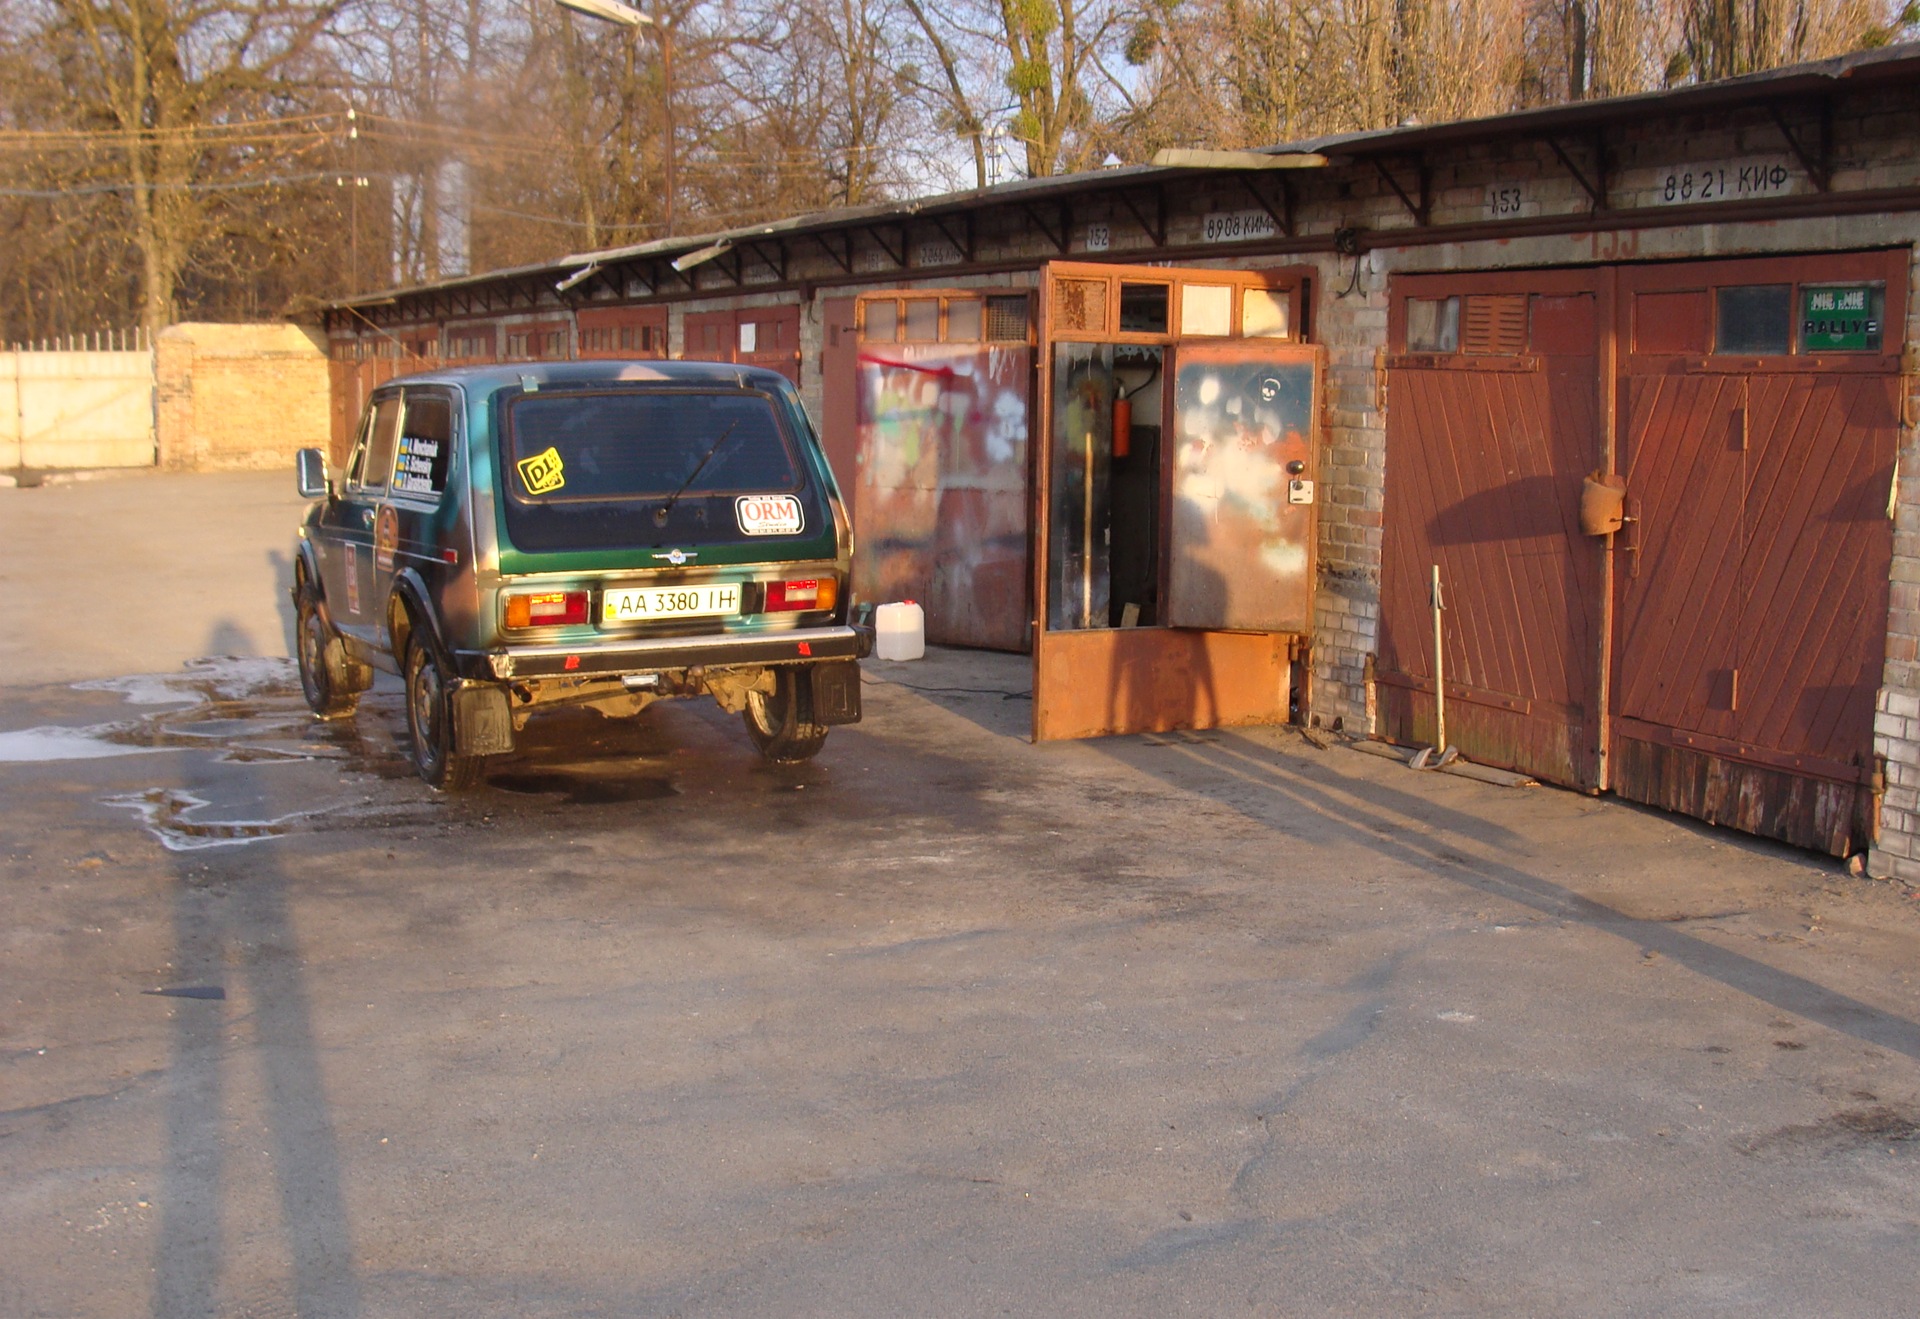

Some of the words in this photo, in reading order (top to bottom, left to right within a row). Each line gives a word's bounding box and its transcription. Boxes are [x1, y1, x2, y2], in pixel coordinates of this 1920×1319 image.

[1664, 169, 1725, 201] 8821
[1738, 165, 1788, 192] КИФ
[1491, 188, 1521, 214] 153
[1089, 228, 1108, 246] 152
[1207, 216, 1240, 239] 8908
[1804, 320, 1877, 334] RALLYE
[744, 502, 796, 520] ORM
[620, 595, 647, 613] AA
[655, 592, 699, 611] 3380
[709, 590, 733, 609] IH
